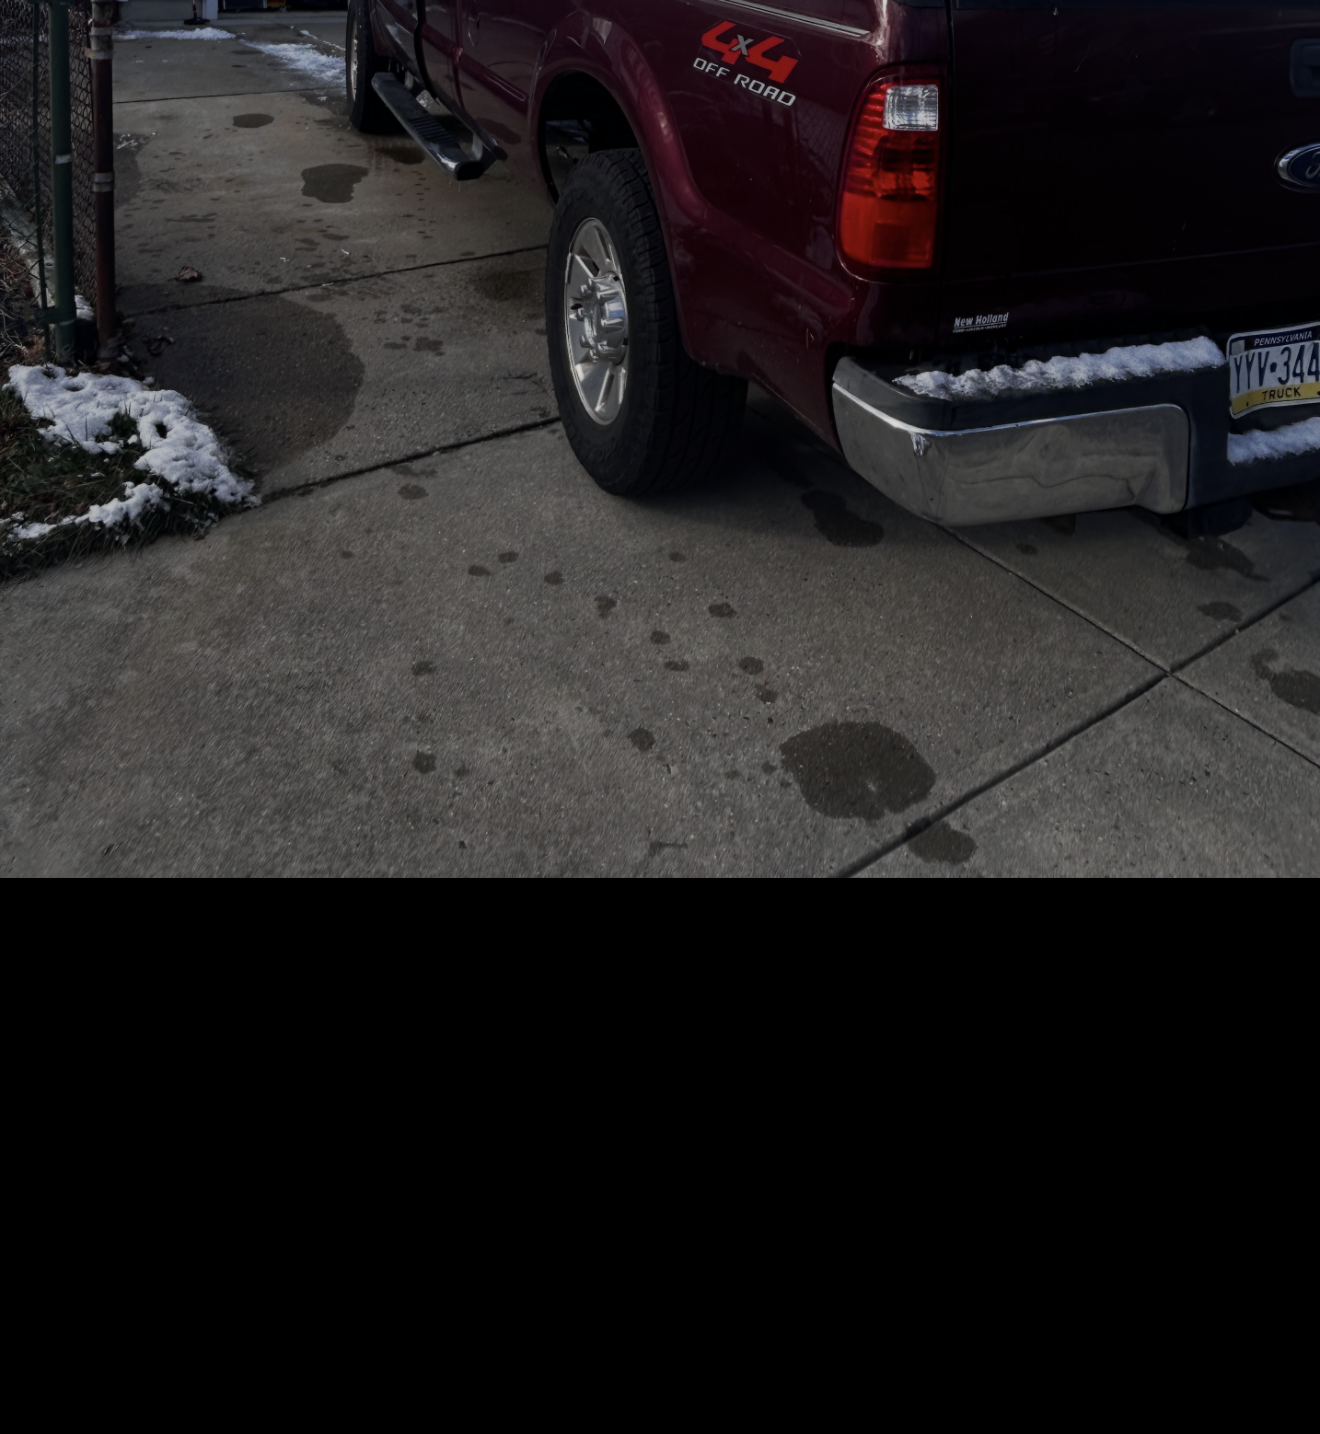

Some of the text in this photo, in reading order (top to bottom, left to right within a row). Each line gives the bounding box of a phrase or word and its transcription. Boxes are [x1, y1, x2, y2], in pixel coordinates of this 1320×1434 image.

[693, 57, 797, 106] OFF ROAD
[954, 312, 1009, 327] New Holland
[1253, 330, 1313, 347] PENNSYLVANIA
[1261, 386, 1302, 403] TRUCK
